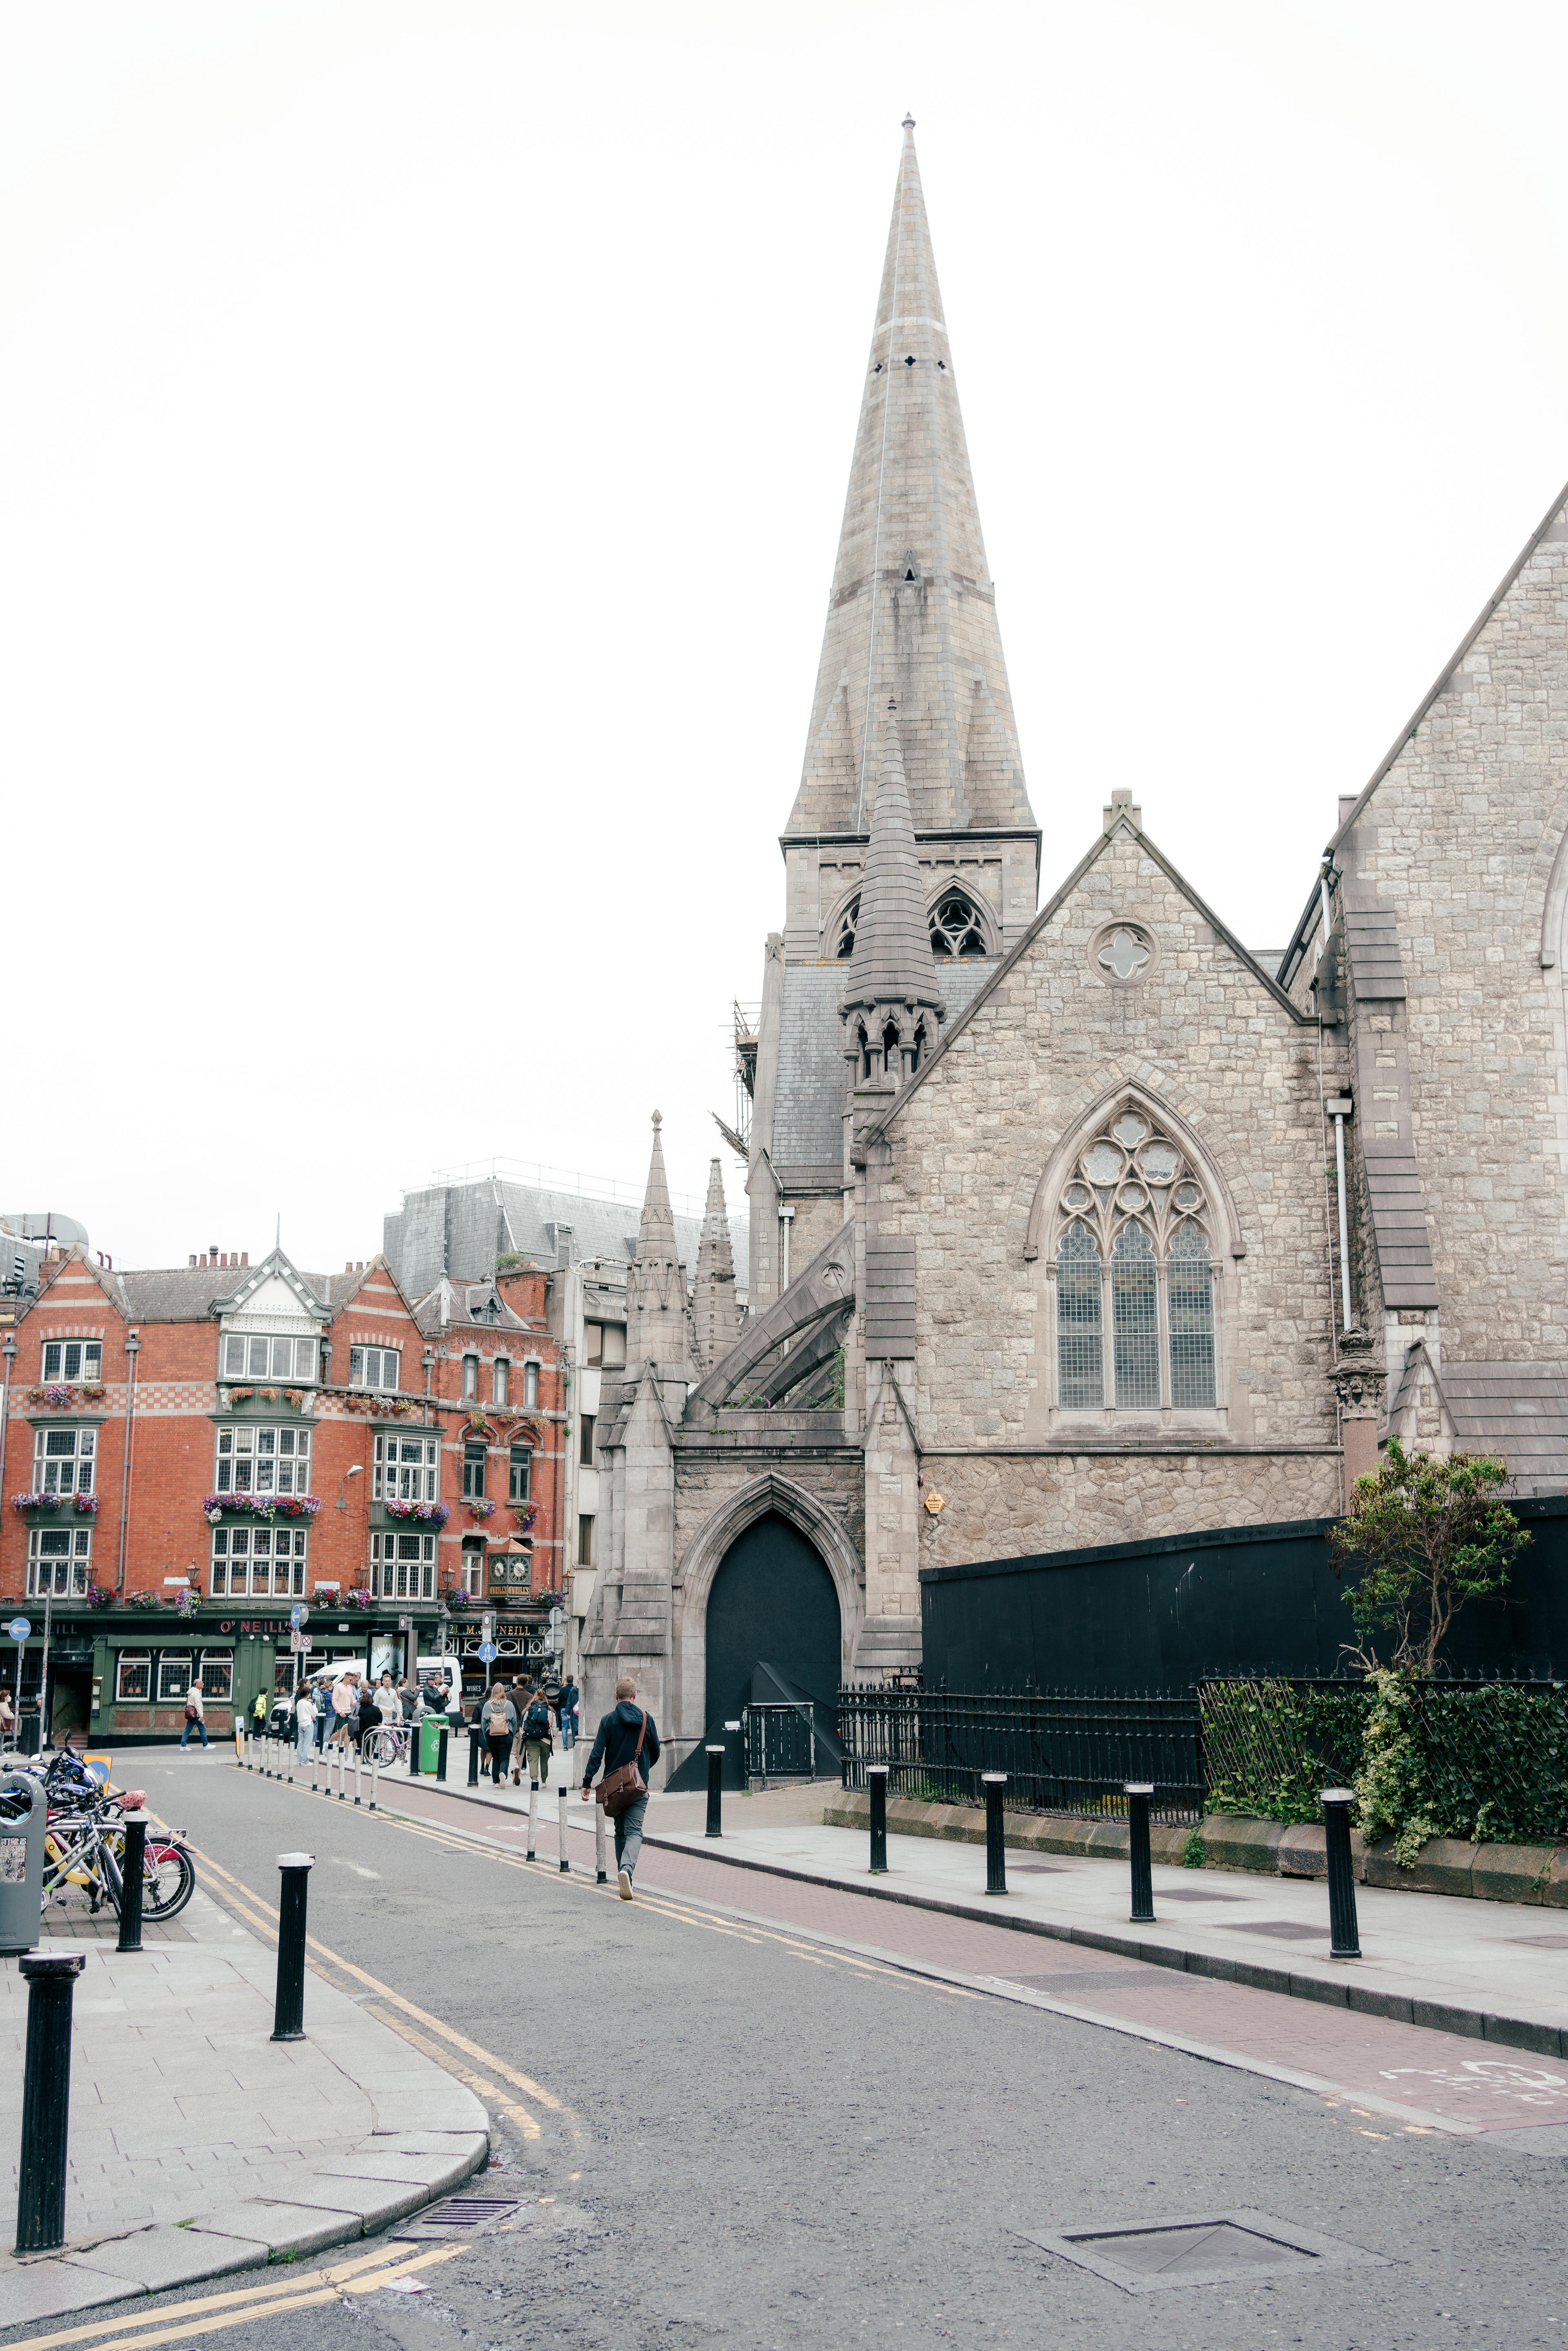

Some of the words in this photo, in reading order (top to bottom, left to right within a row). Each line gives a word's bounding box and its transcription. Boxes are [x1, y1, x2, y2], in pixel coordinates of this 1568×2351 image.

[490, 1586, 507, 1594] O'NEILL'S
[508, 1586, 529, 1595] O'NEILL'S
[2, 1805, 19, 1818] MOBY
